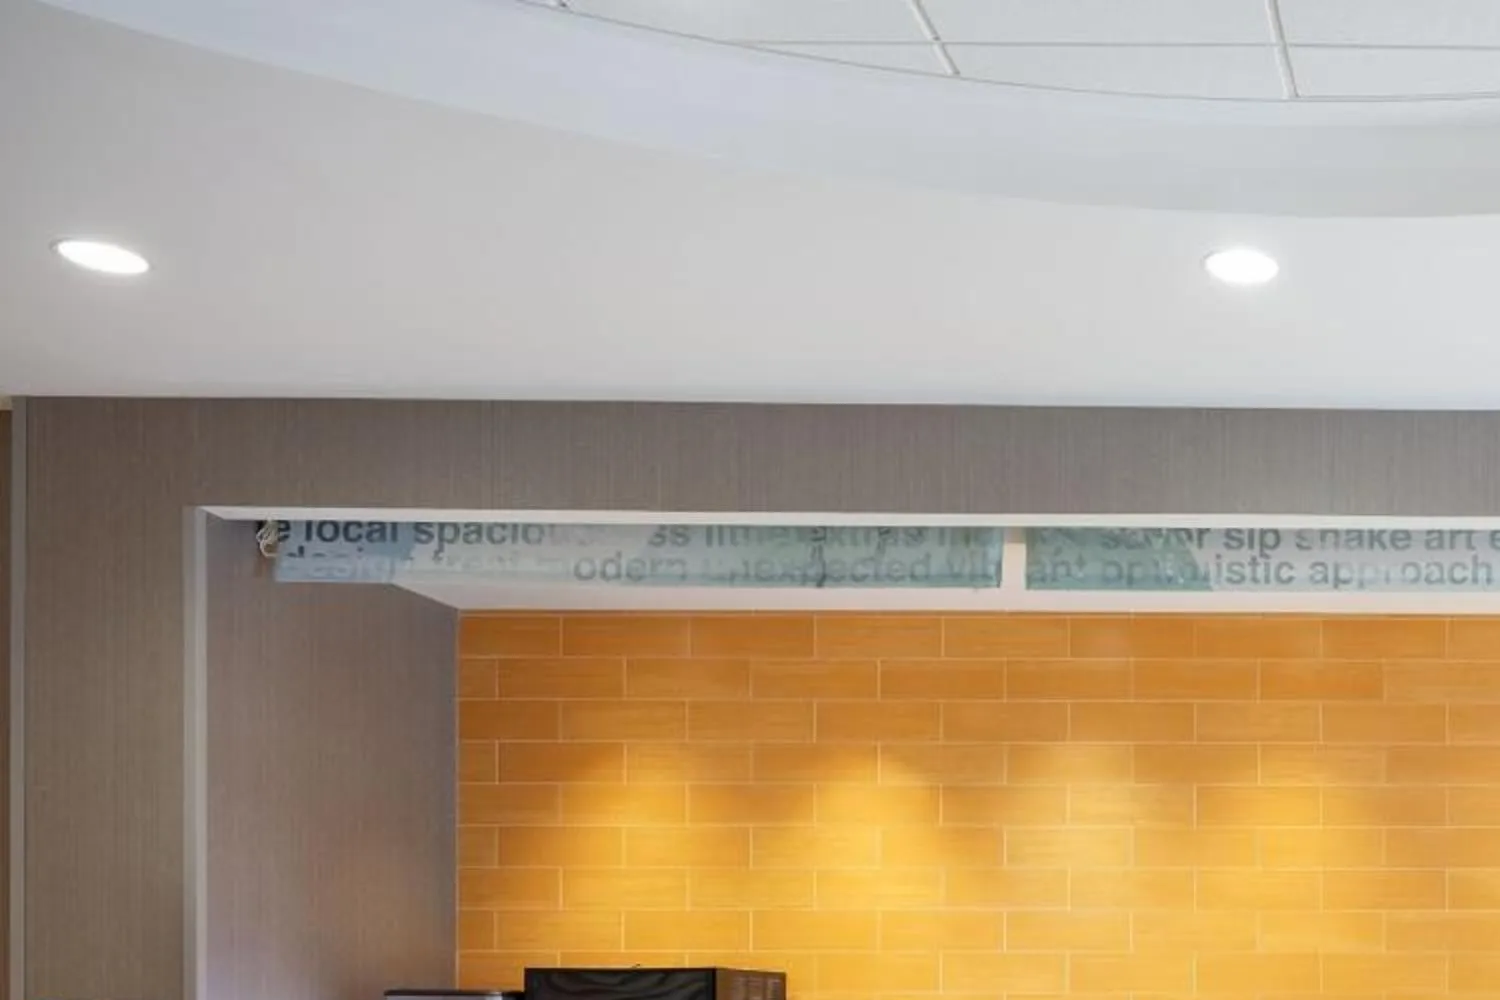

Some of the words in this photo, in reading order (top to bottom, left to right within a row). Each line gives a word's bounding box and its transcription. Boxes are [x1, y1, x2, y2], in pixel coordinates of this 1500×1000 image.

[1223, 527, 1282, 557] sip
[570, 551, 688, 582] odern
[1307, 552, 1493, 589] approach
